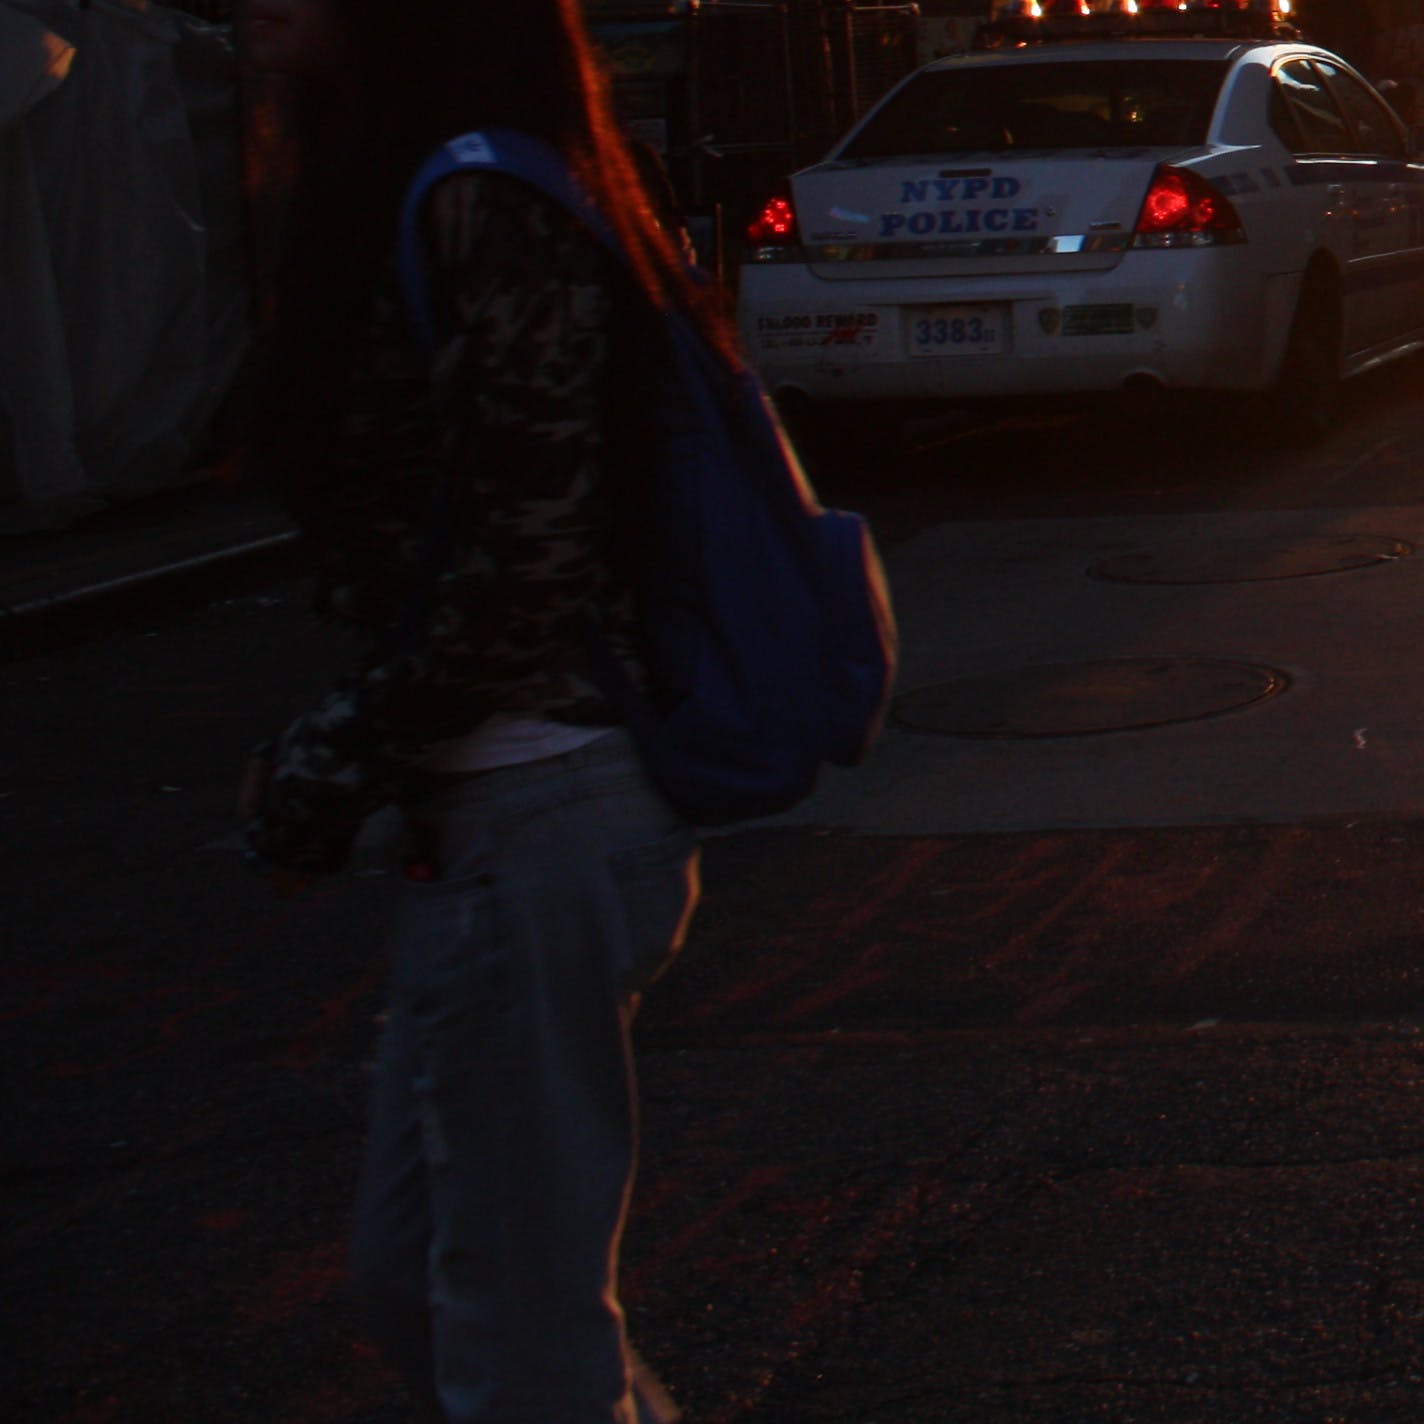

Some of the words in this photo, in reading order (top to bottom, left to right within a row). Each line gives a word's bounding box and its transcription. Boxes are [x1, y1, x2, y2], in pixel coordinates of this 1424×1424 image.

[900, 177, 1020, 203] NYPD
[880, 208, 1039, 237] POLICE
[816, 313, 878, 329] REWARD
[915, 317, 984, 345] 3383
